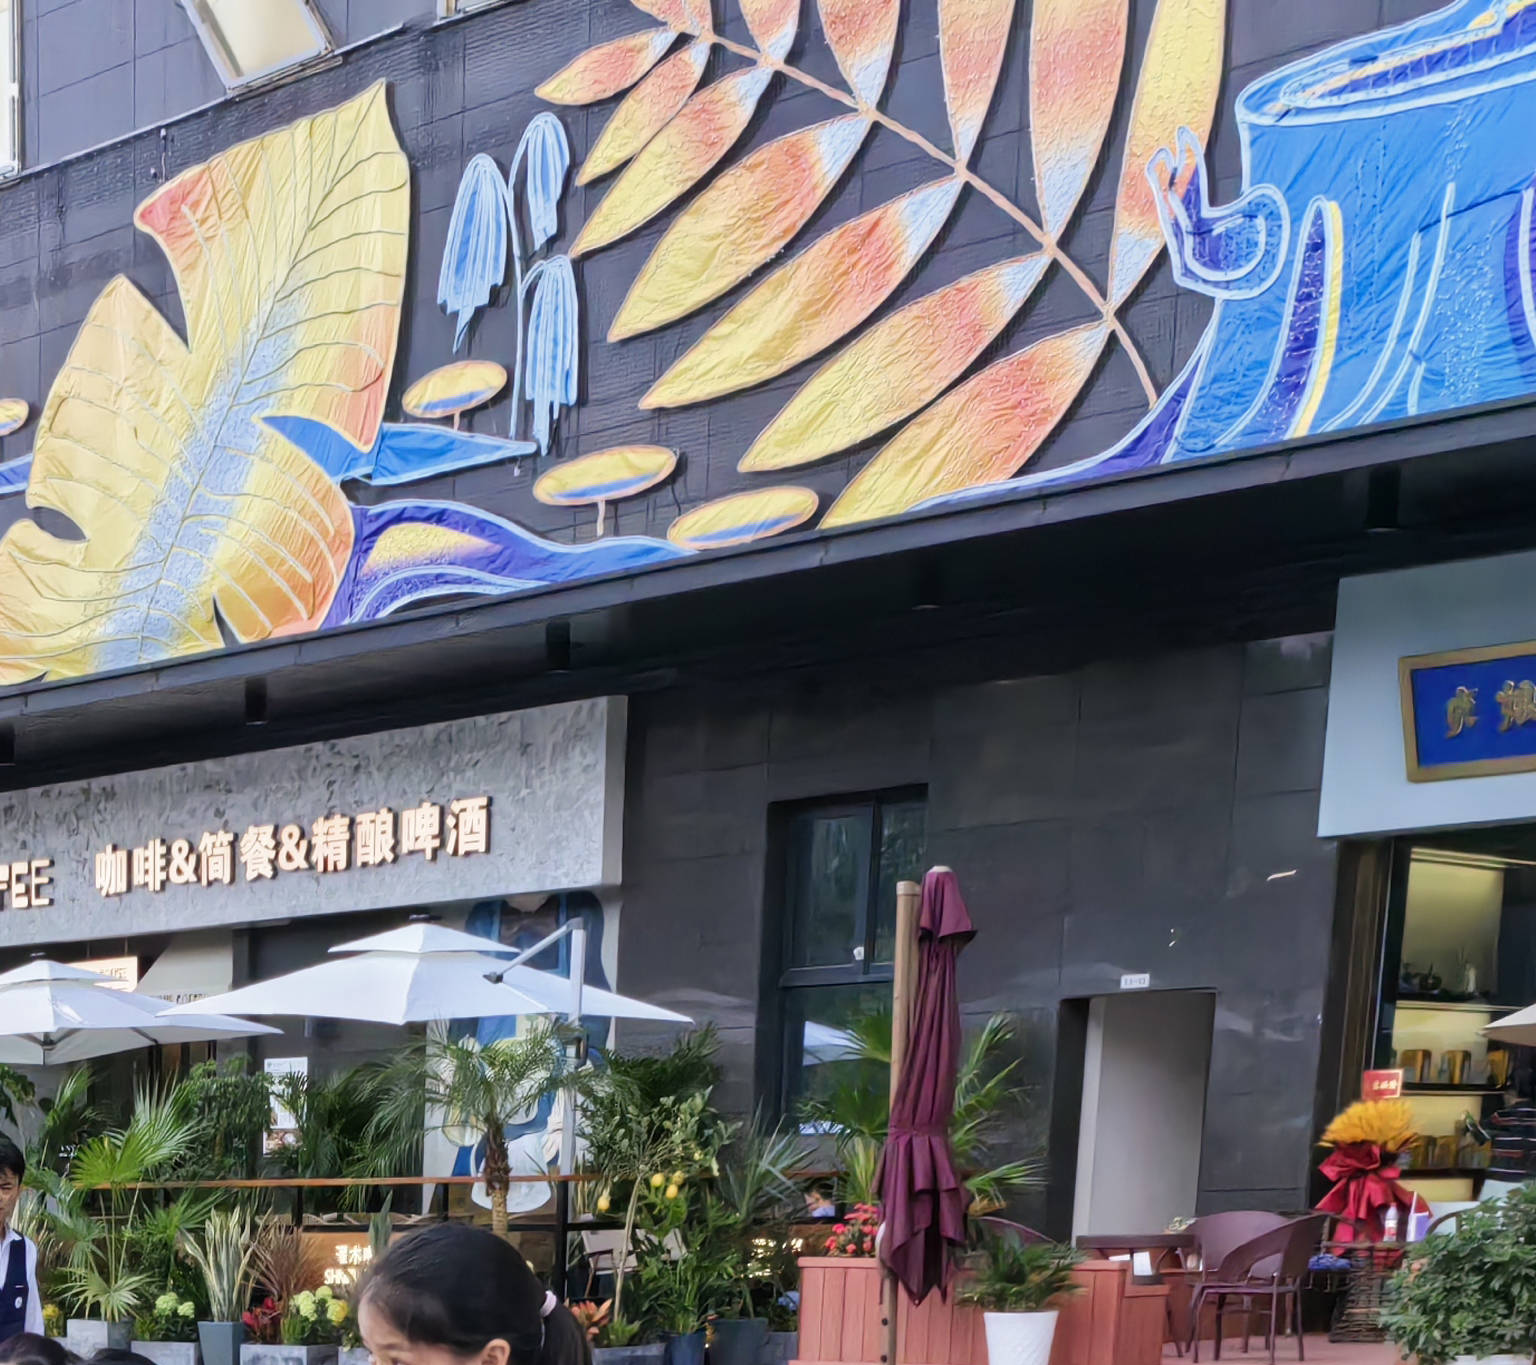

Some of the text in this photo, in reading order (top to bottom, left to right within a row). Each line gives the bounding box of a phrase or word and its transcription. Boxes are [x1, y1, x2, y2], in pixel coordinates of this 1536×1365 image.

[95, 795, 492, 897] 咖啡&简餐&精酿啤酒
